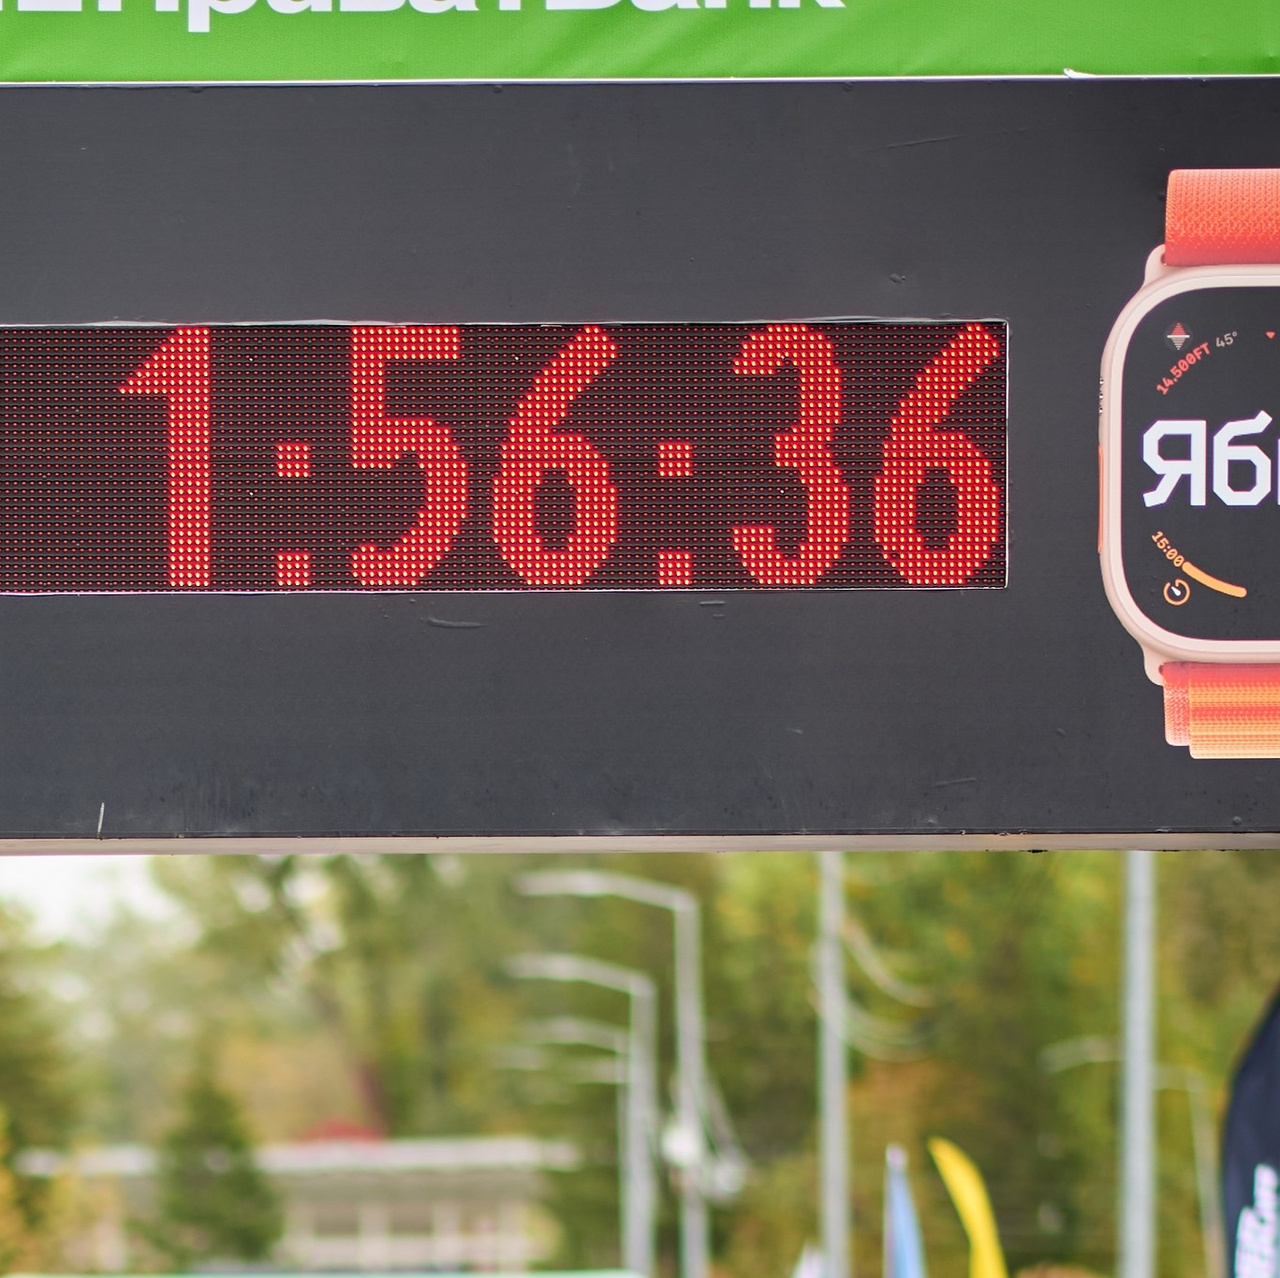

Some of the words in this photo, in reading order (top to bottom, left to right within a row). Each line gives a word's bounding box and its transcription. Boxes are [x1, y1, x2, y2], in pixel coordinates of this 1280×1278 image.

[118, 323, 1002, 588] 1:56:36
[1143, 411, 1280, 507] Яб
[1151, 531, 1185, 567] 15:00
